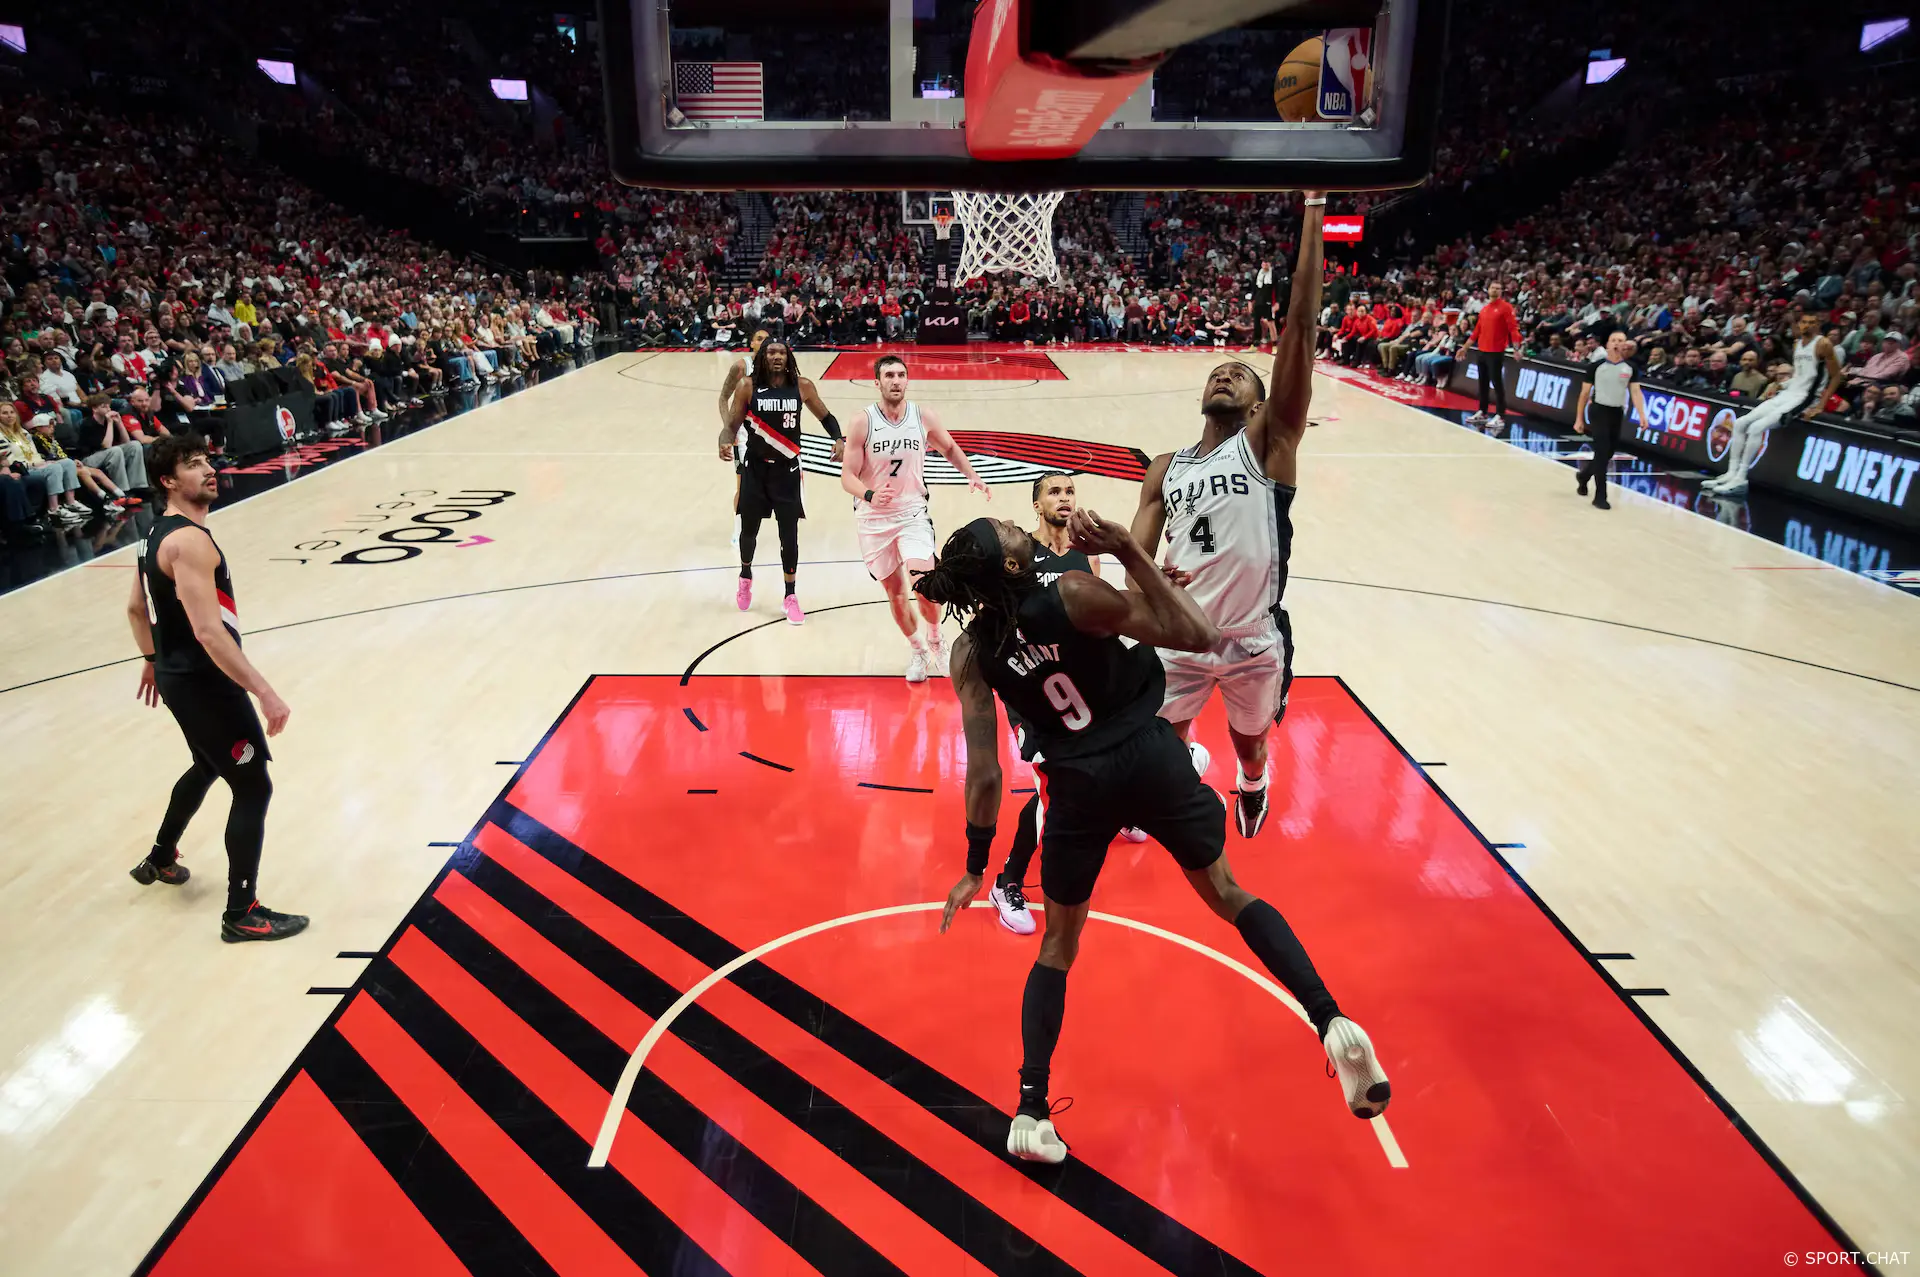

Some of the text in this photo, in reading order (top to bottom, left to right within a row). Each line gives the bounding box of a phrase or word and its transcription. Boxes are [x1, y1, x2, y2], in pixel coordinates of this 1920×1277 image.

[1324, 92, 1347, 111] NBA
[757, 398, 798, 412] PORTLAND
[1516, 367, 1537, 399] UP
[1533, 373, 1571, 410] NEXT
[782, 412, 797, 429] 35
[873, 438, 920, 456] SPURS
[889, 459, 903, 477] 7
[1796, 435, 1920, 507] UP NEXT
[1164, 473, 1249, 519] SPURS
[269, 489, 438, 565] center
[330, 489, 517, 565] moda
[1189, 514, 1216, 555] 4
[1042, 672, 1093, 732] 9
